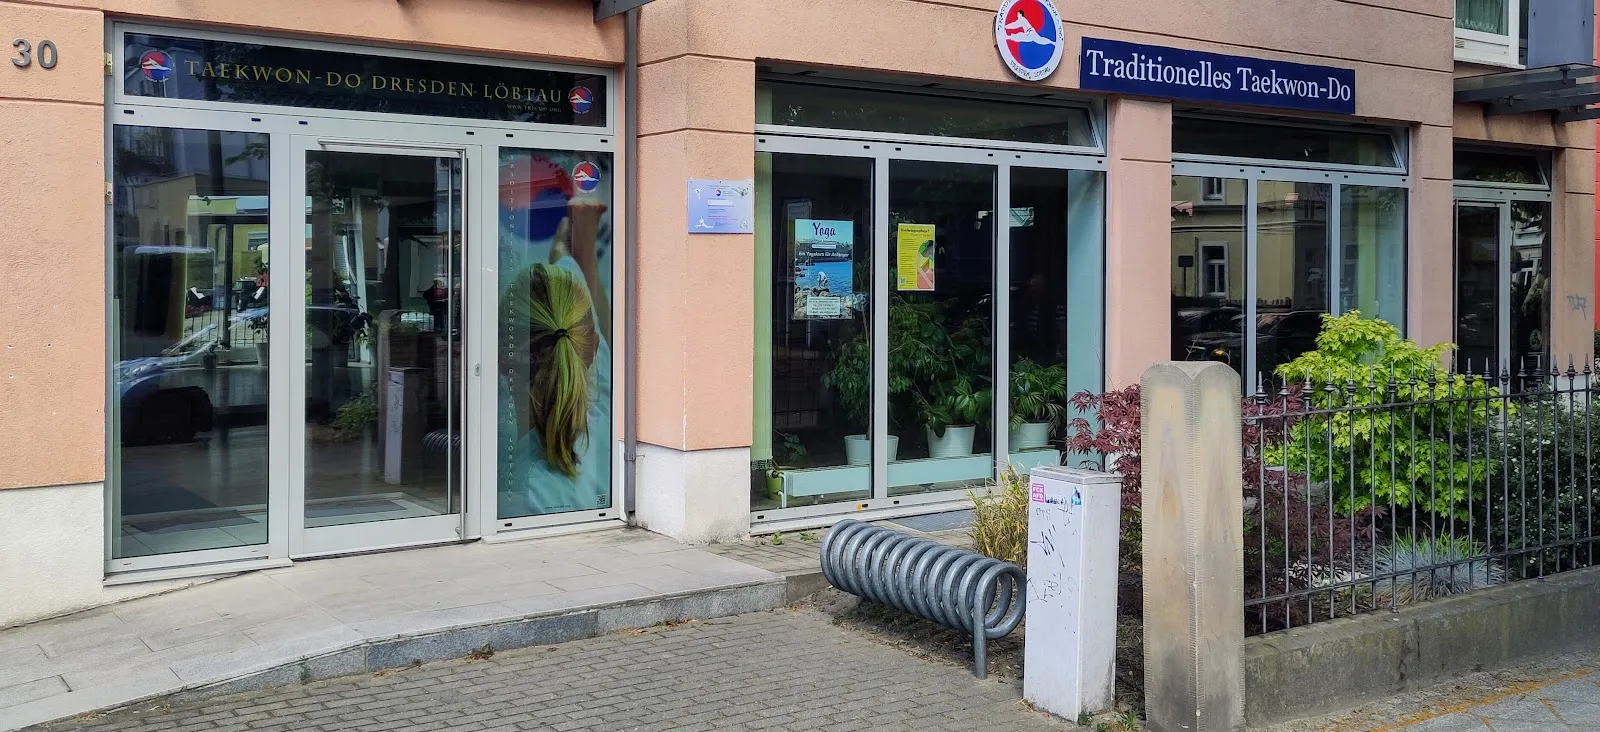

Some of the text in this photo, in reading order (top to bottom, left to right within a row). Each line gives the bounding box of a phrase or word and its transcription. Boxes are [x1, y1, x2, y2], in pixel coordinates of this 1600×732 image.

[11, 38, 58, 69] 30
[184, 60, 562, 103] TAEKWON-DO DRESDEN LÖBTAU
[1086, 49, 1351, 101] Traditionelles Taekwon-Do
[812, 222, 836, 239] Yoga
